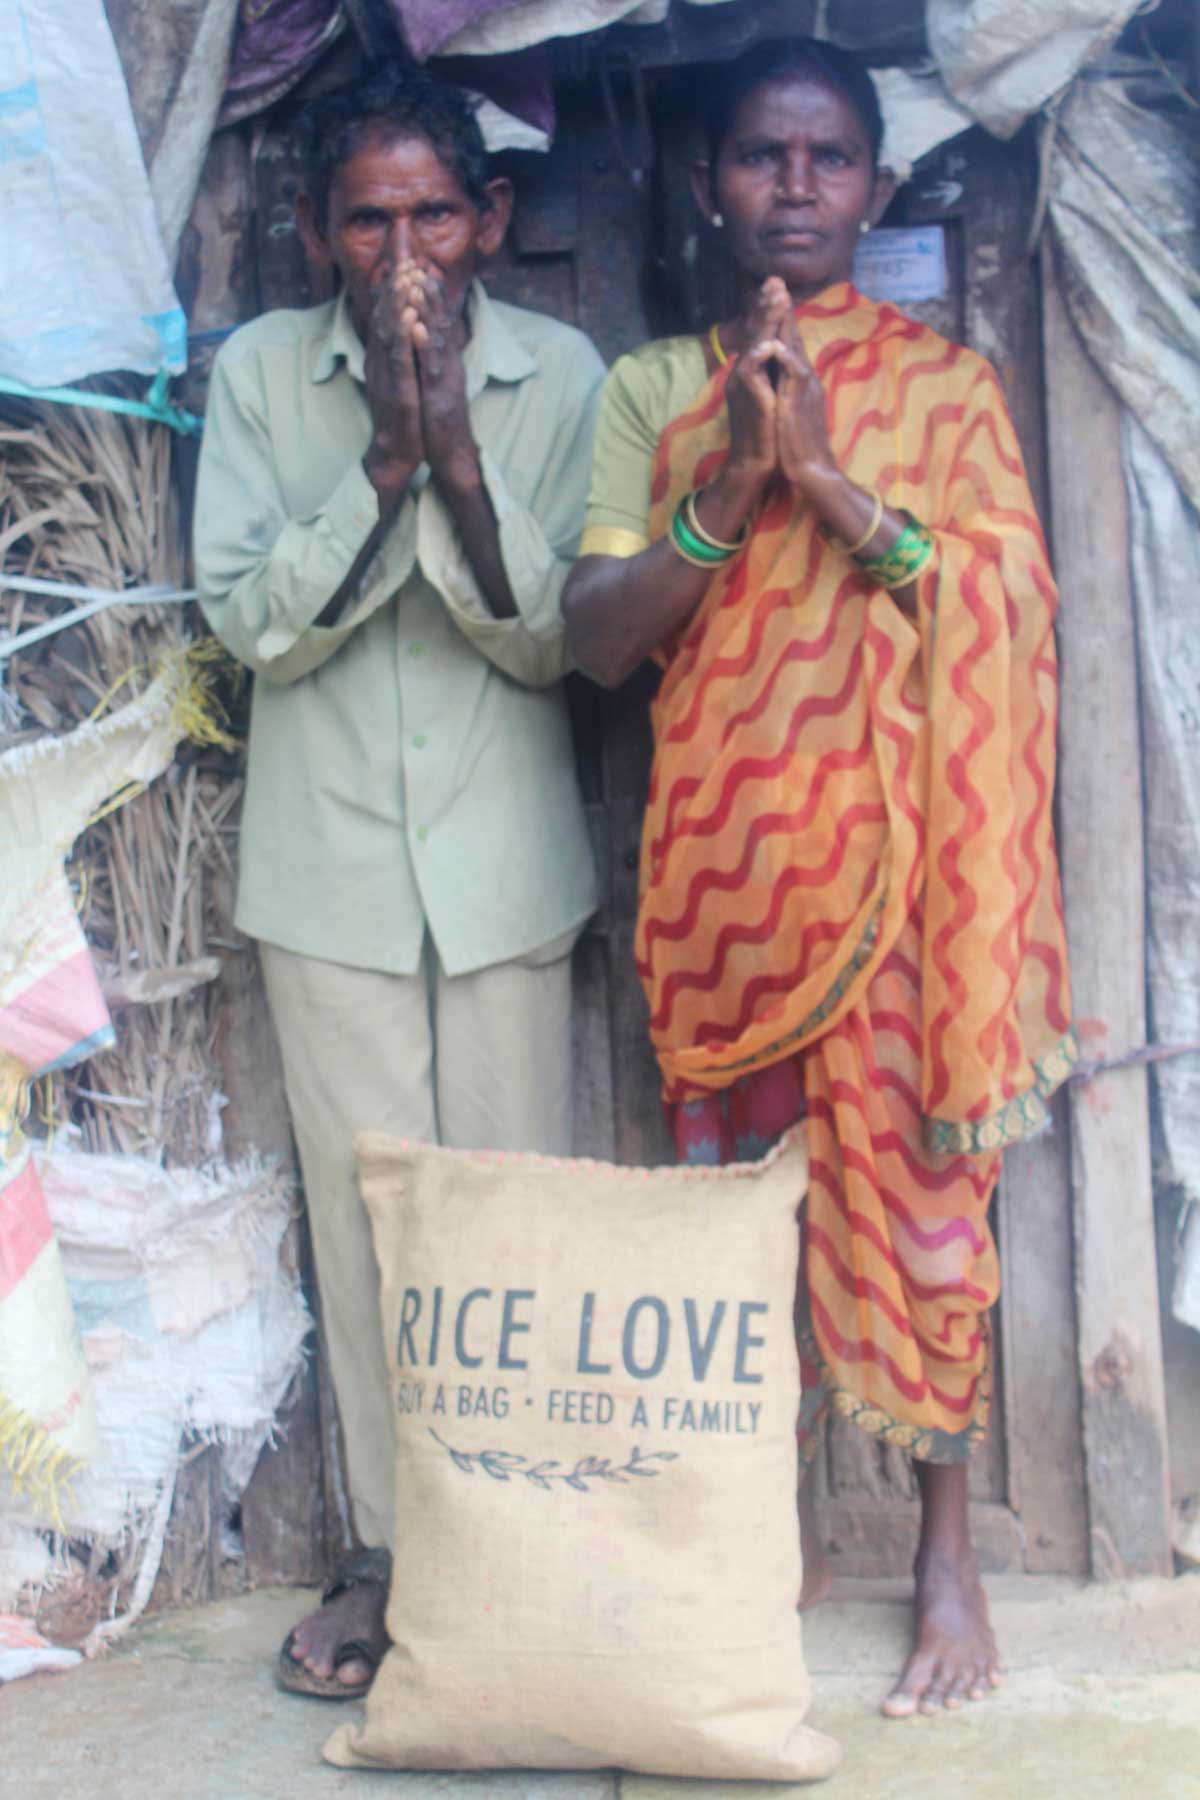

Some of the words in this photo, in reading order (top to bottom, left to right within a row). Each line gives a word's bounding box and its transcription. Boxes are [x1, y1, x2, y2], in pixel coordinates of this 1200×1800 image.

[397, 1286, 536, 1370] RICE
[577, 1292, 769, 1384] LOVE
[398, 1383, 425, 1414] BUY
[431, 1384, 447, 1415] A
[457, 1385, 510, 1419] BAG
[547, 1389, 615, 1426] FEED
[631, 1396, 649, 1429] A
[663, 1397, 762, 1433] FAMILY
